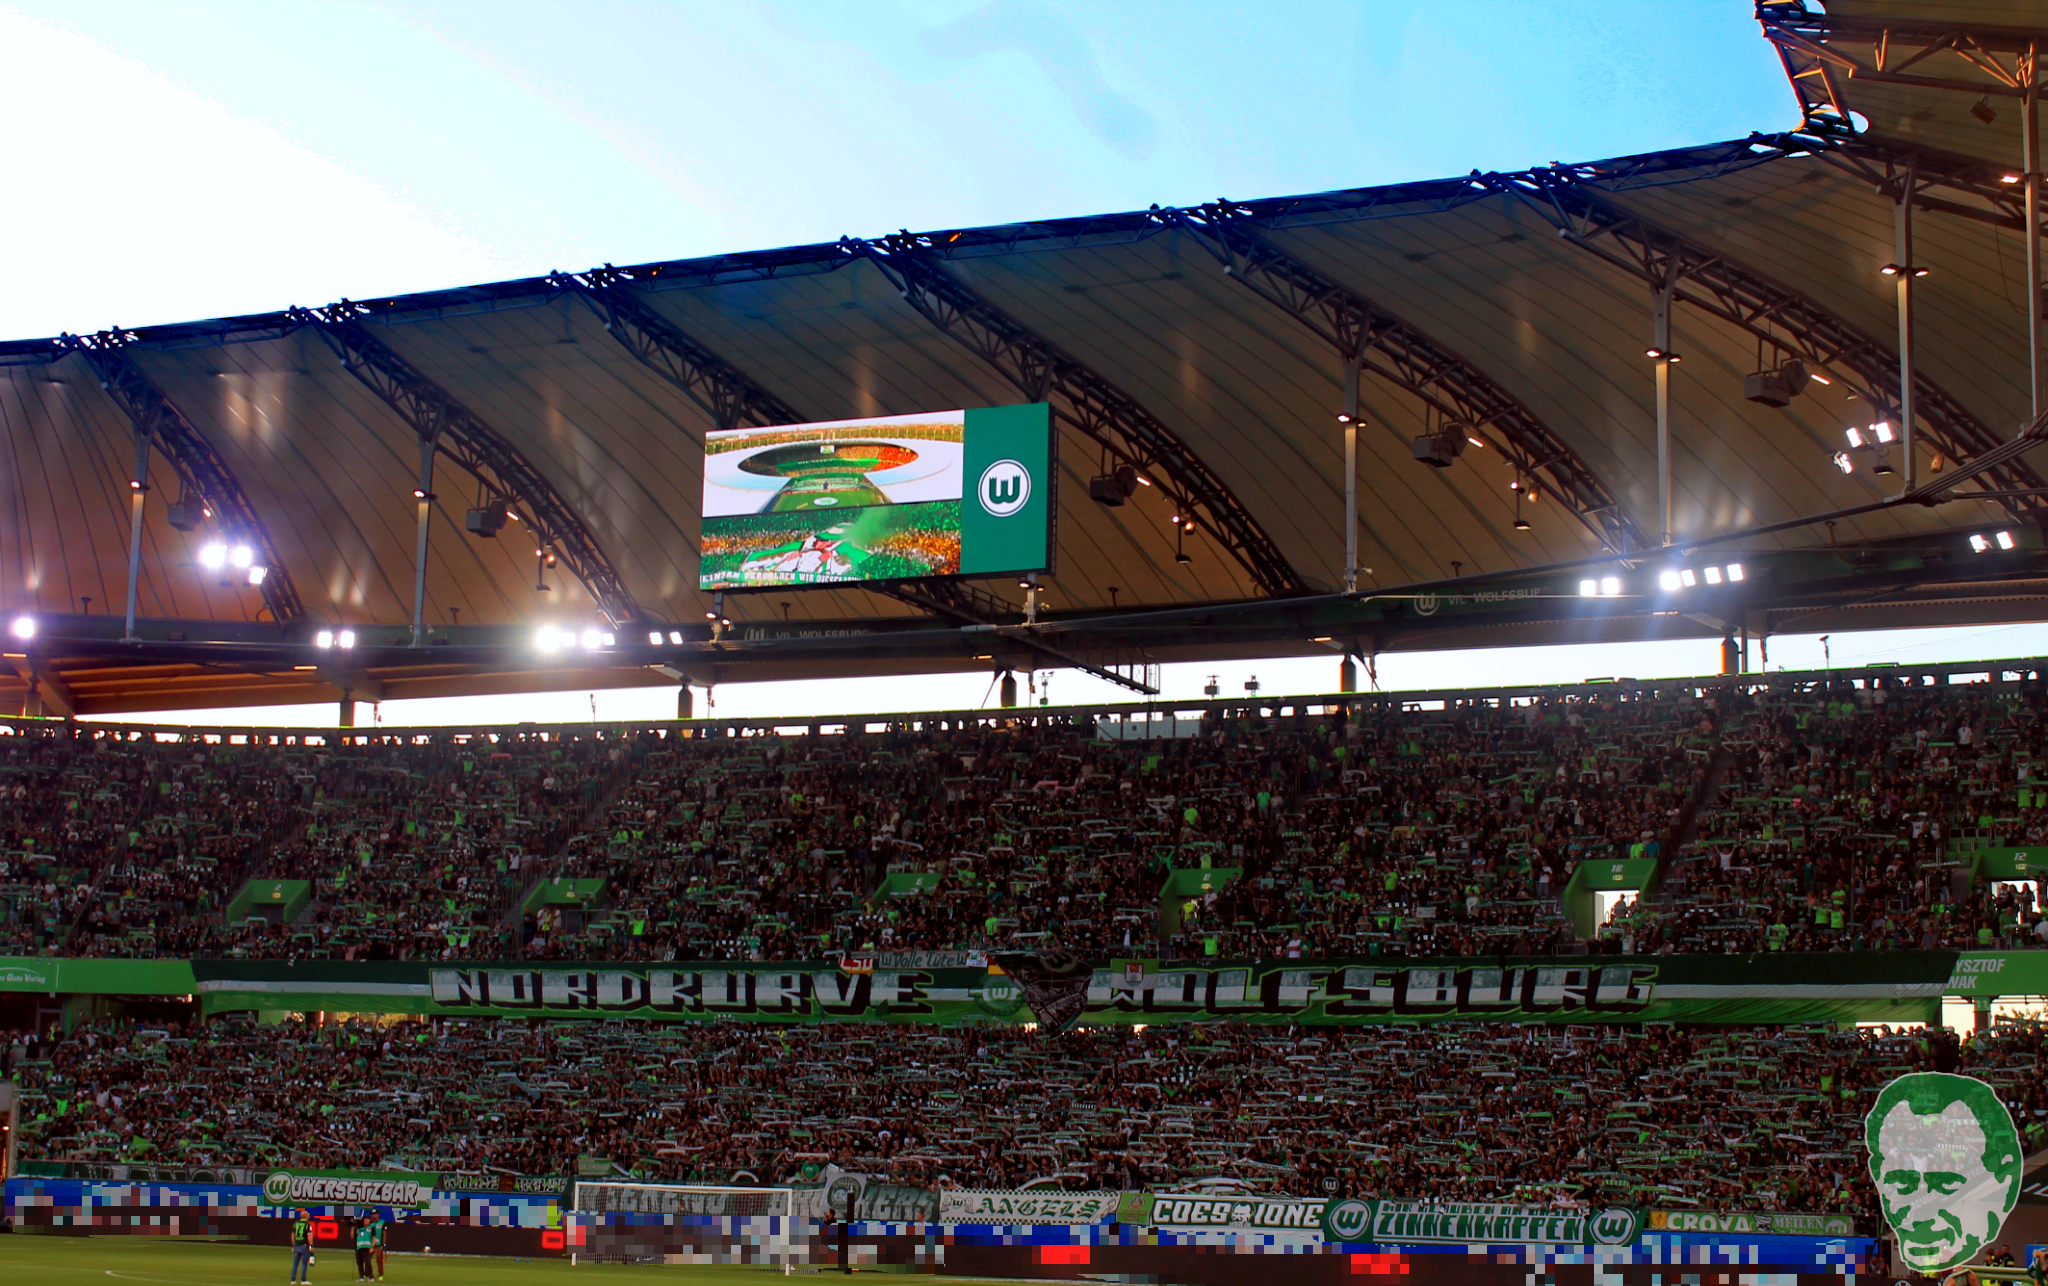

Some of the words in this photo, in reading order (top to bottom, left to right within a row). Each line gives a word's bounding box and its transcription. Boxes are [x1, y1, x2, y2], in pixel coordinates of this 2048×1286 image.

[2013, 852, 2028, 861] 12
[893, 951, 923, 968] Volle
[1955, 958, 2006, 973] YSZTOF
[431, 969, 924, 1009] NORDKURVE
[1086, 966, 1657, 1010] WOLFSBURG
[1945, 974, 1978, 989] NAK
[290, 1177, 419, 1206] UNERSETZBAR
[975, 1197, 1101, 1218] ANGELS
[1377, 1212, 1582, 1241] ZINNENWAPPEN
